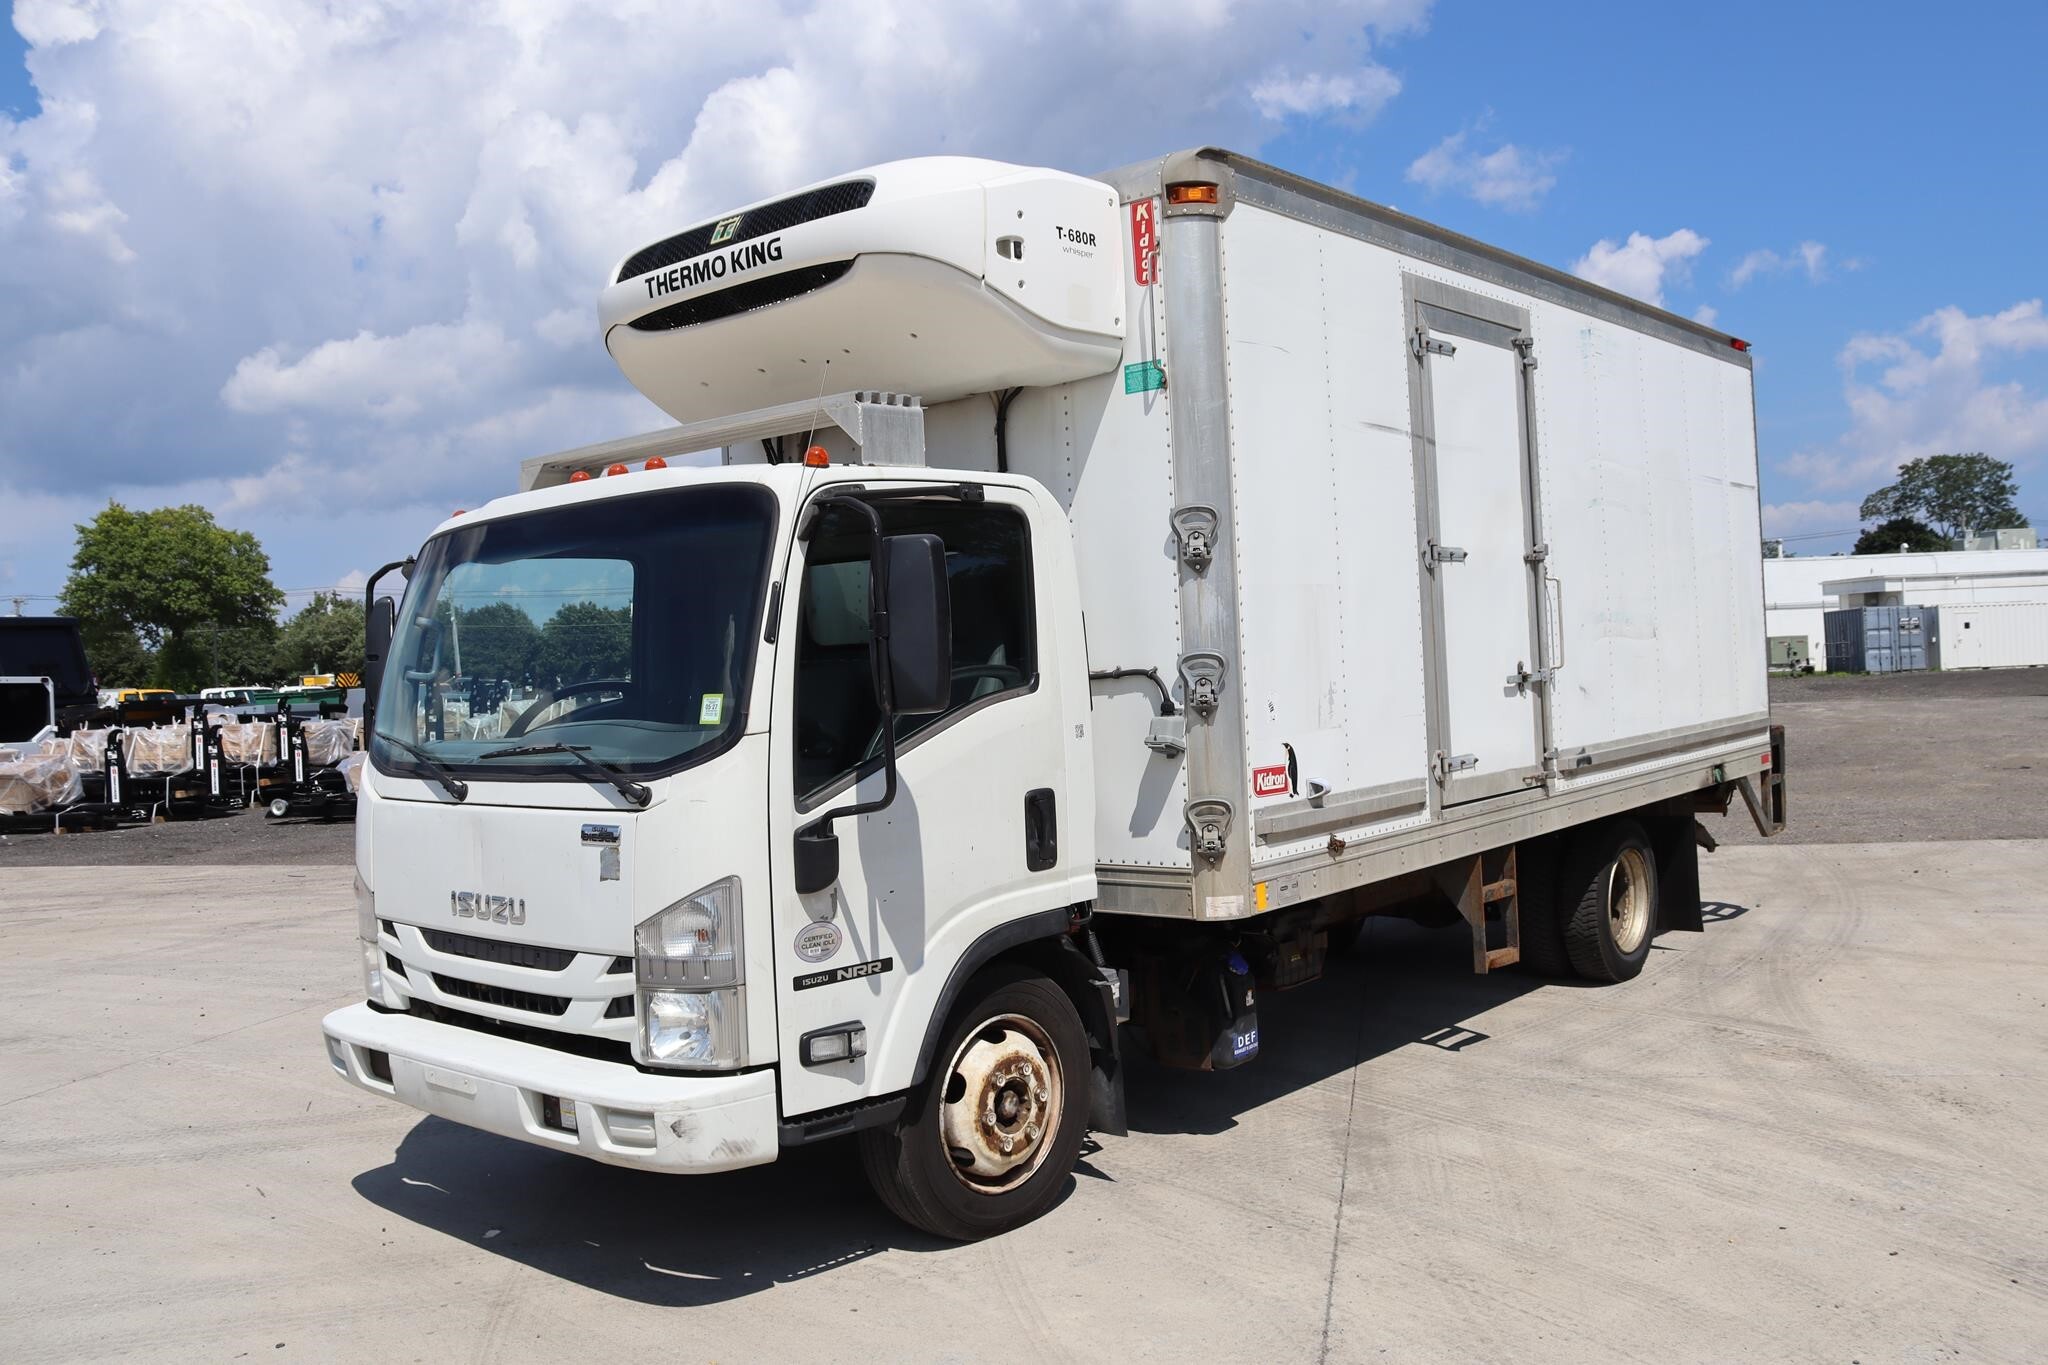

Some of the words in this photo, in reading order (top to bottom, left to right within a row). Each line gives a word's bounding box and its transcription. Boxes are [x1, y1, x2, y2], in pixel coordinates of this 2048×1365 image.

[1056, 226, 1096, 247] T-680R
[1136, 203, 1150, 281] Kidron
[644, 255, 726, 299] THERMO
[731, 237, 783, 273] KING
[1257, 772, 1286, 791] Kidron
[451, 890, 526, 925] ISUZU
[801, 941, 821, 950] CLEAN
[822, 939, 836, 948] IDLE
[803, 933, 833, 943] CERTIFIED
[802, 974, 829, 986] ISUZU
[836, 961, 882, 980] NRR
[1238, 1031, 1256, 1048] DEF
